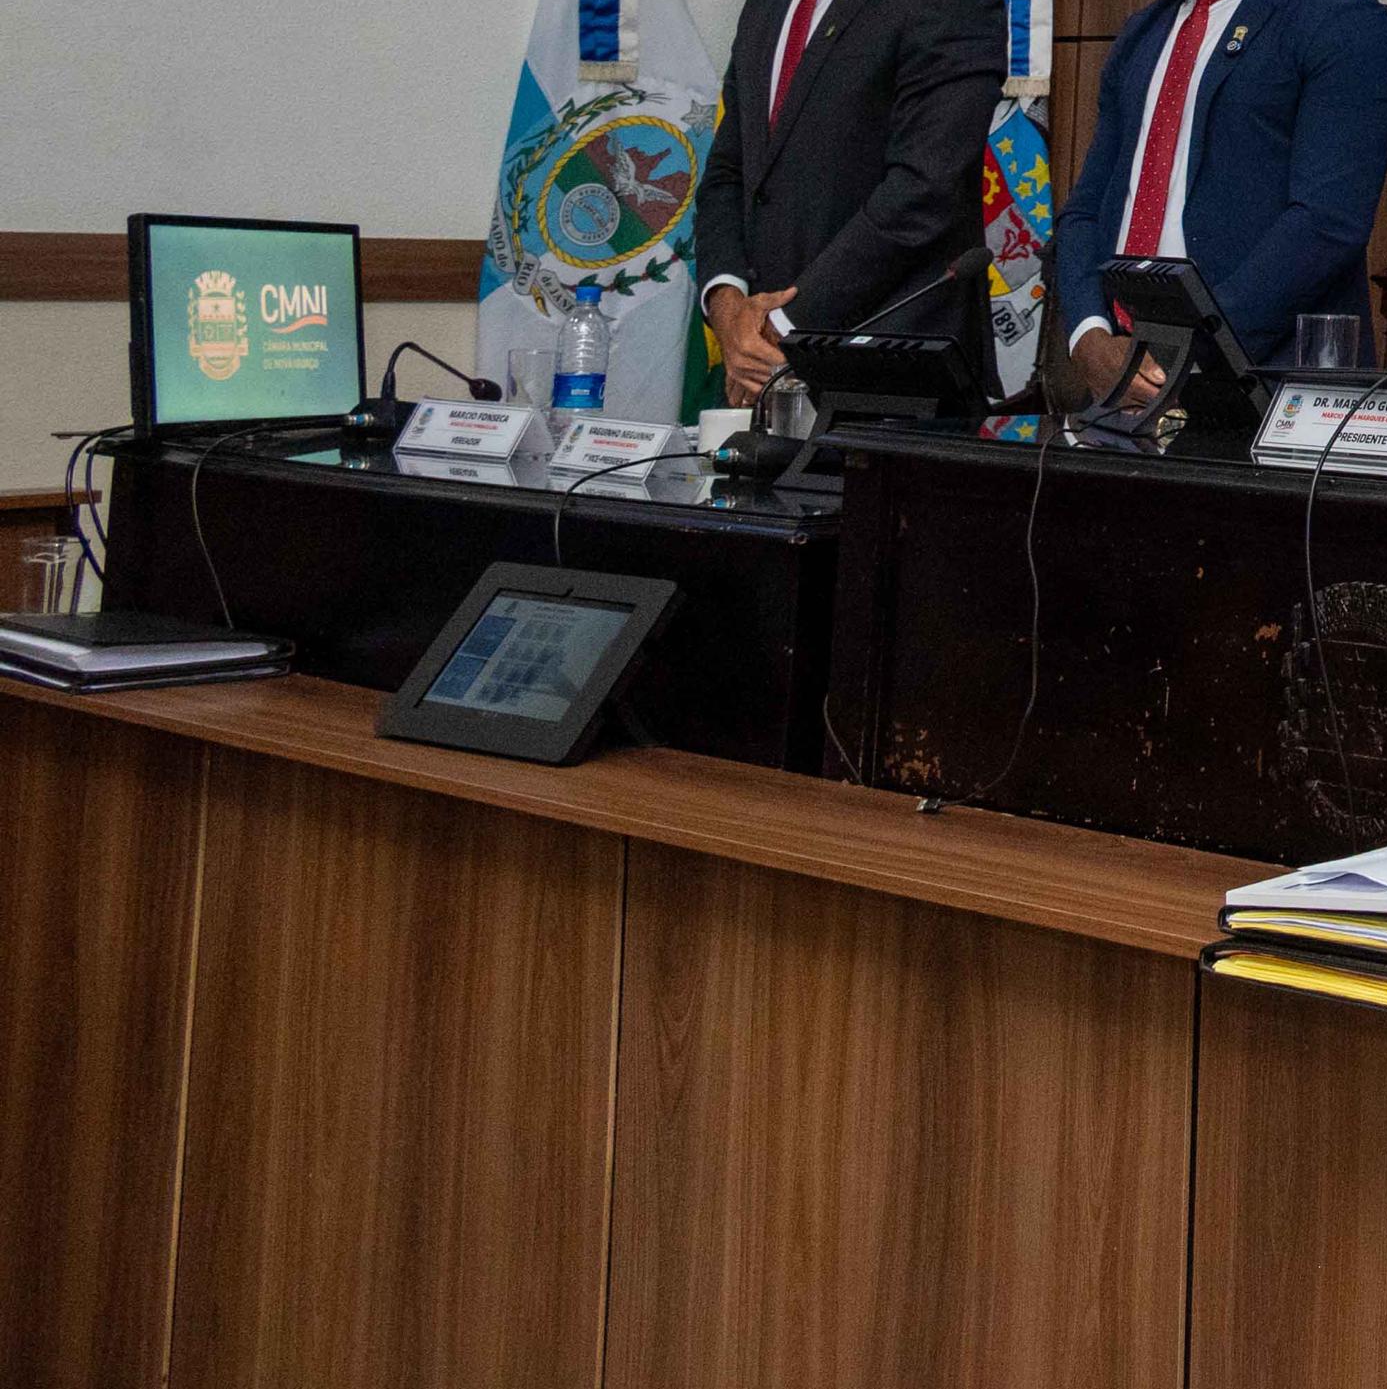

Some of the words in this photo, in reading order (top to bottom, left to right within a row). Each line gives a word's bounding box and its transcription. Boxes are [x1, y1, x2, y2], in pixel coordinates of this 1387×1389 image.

[517, 262, 534, 286] RIO
[261, 284, 327, 323] CMNI
[993, 307, 1018, 342] 1891
[1313, 397, 1330, 408] DR.
